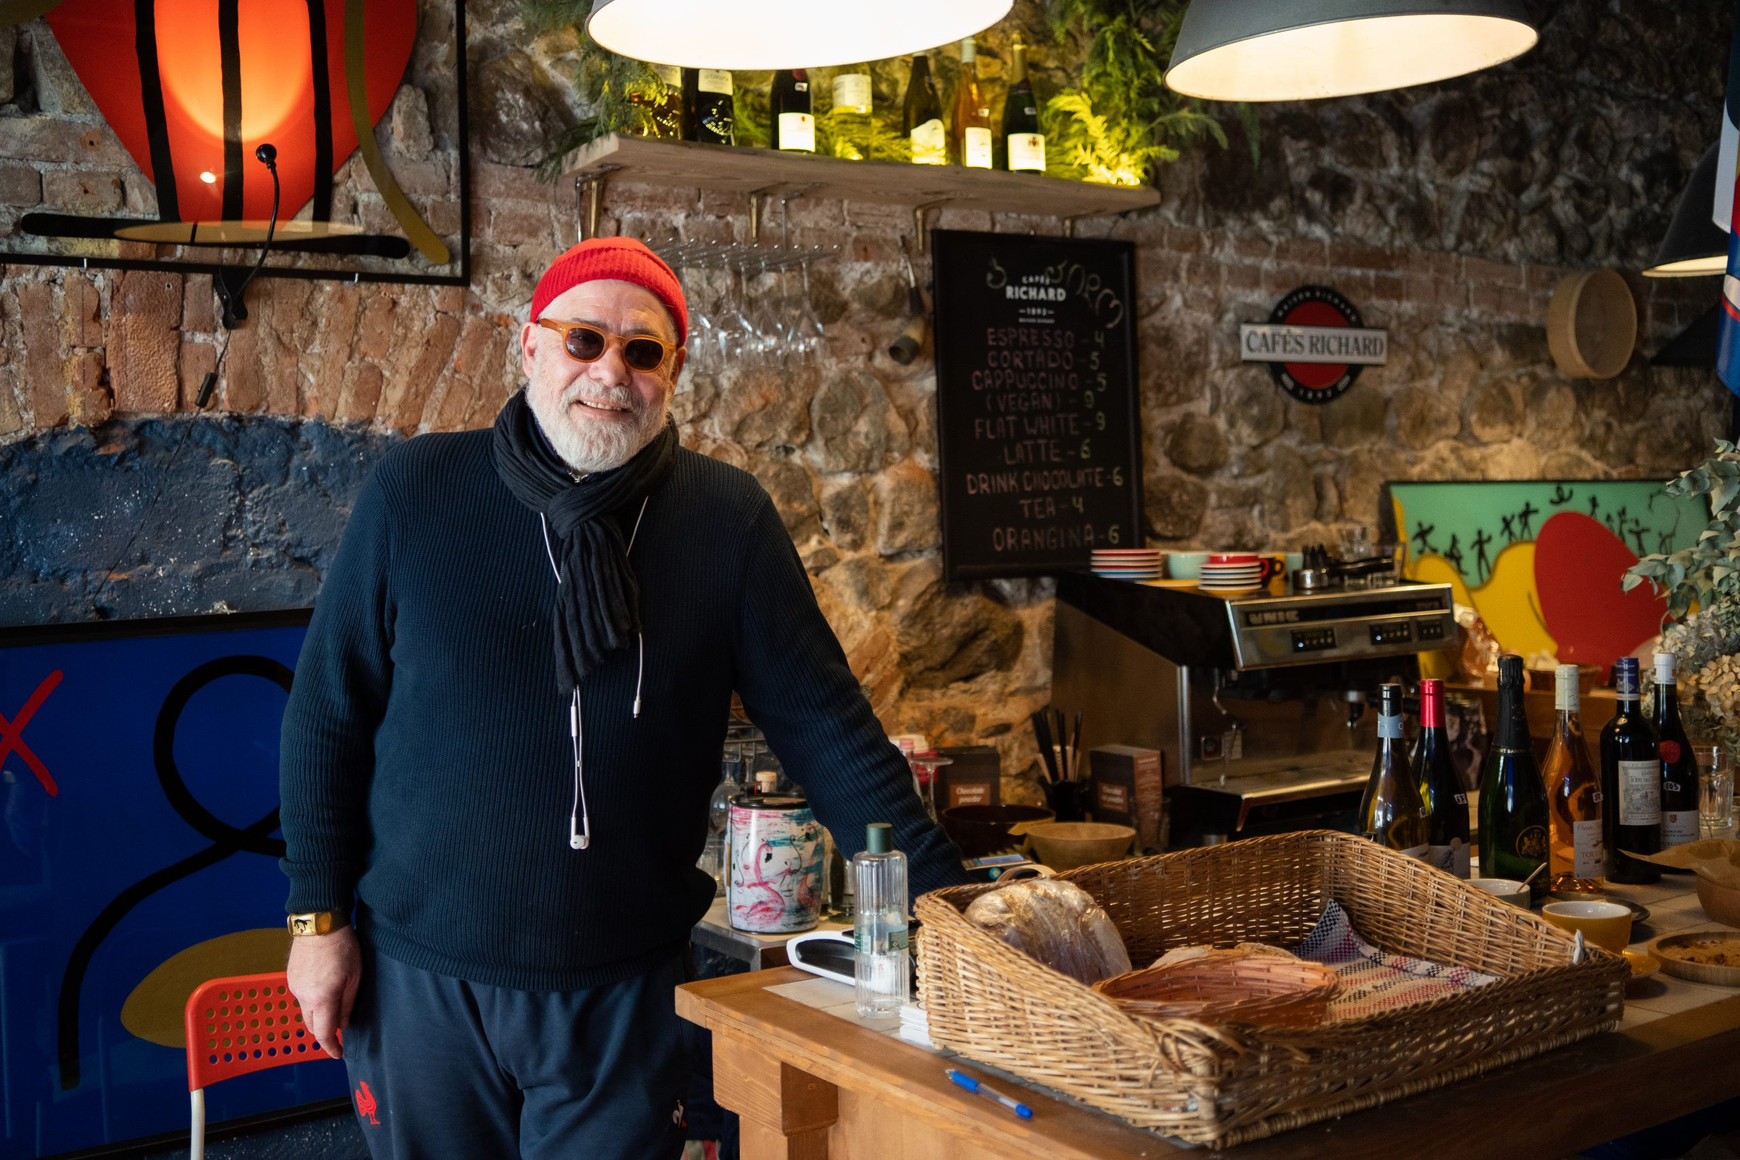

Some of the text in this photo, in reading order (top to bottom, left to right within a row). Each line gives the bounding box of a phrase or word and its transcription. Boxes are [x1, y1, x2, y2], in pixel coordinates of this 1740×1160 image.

[1005, 286, 1066, 301] RICHARD
[986, 328, 1074, 348] ESPRESSO
[1094, 330, 1105, 348] 4
[1246, 328, 1384, 357] CAFÉS RICHARD
[987, 350, 1074, 370] CORTADO
[1090, 351, 1101, 370] 5
[971, 369, 1079, 391] CAPPUCCINO
[1097, 373, 1108, 392] 5
[974, 416, 1018, 440] FLAT
[1022, 413, 1081, 436] WHITE
[1096, 411, 1106, 431] 9
[1004, 438, 1063, 465] LATTE
[1080, 438, 1092, 459] 6
[966, 472, 1020, 495] DRINK
[1022, 467, 1104, 492] CHOCOLATE
[1112, 466, 1124, 487] 6
[1019, 498, 1057, 520] TEA
[1072, 496, 1084, 514] 4
[992, 523, 1095, 552] ORANGINA
[1108, 524, 1120, 544] 6
